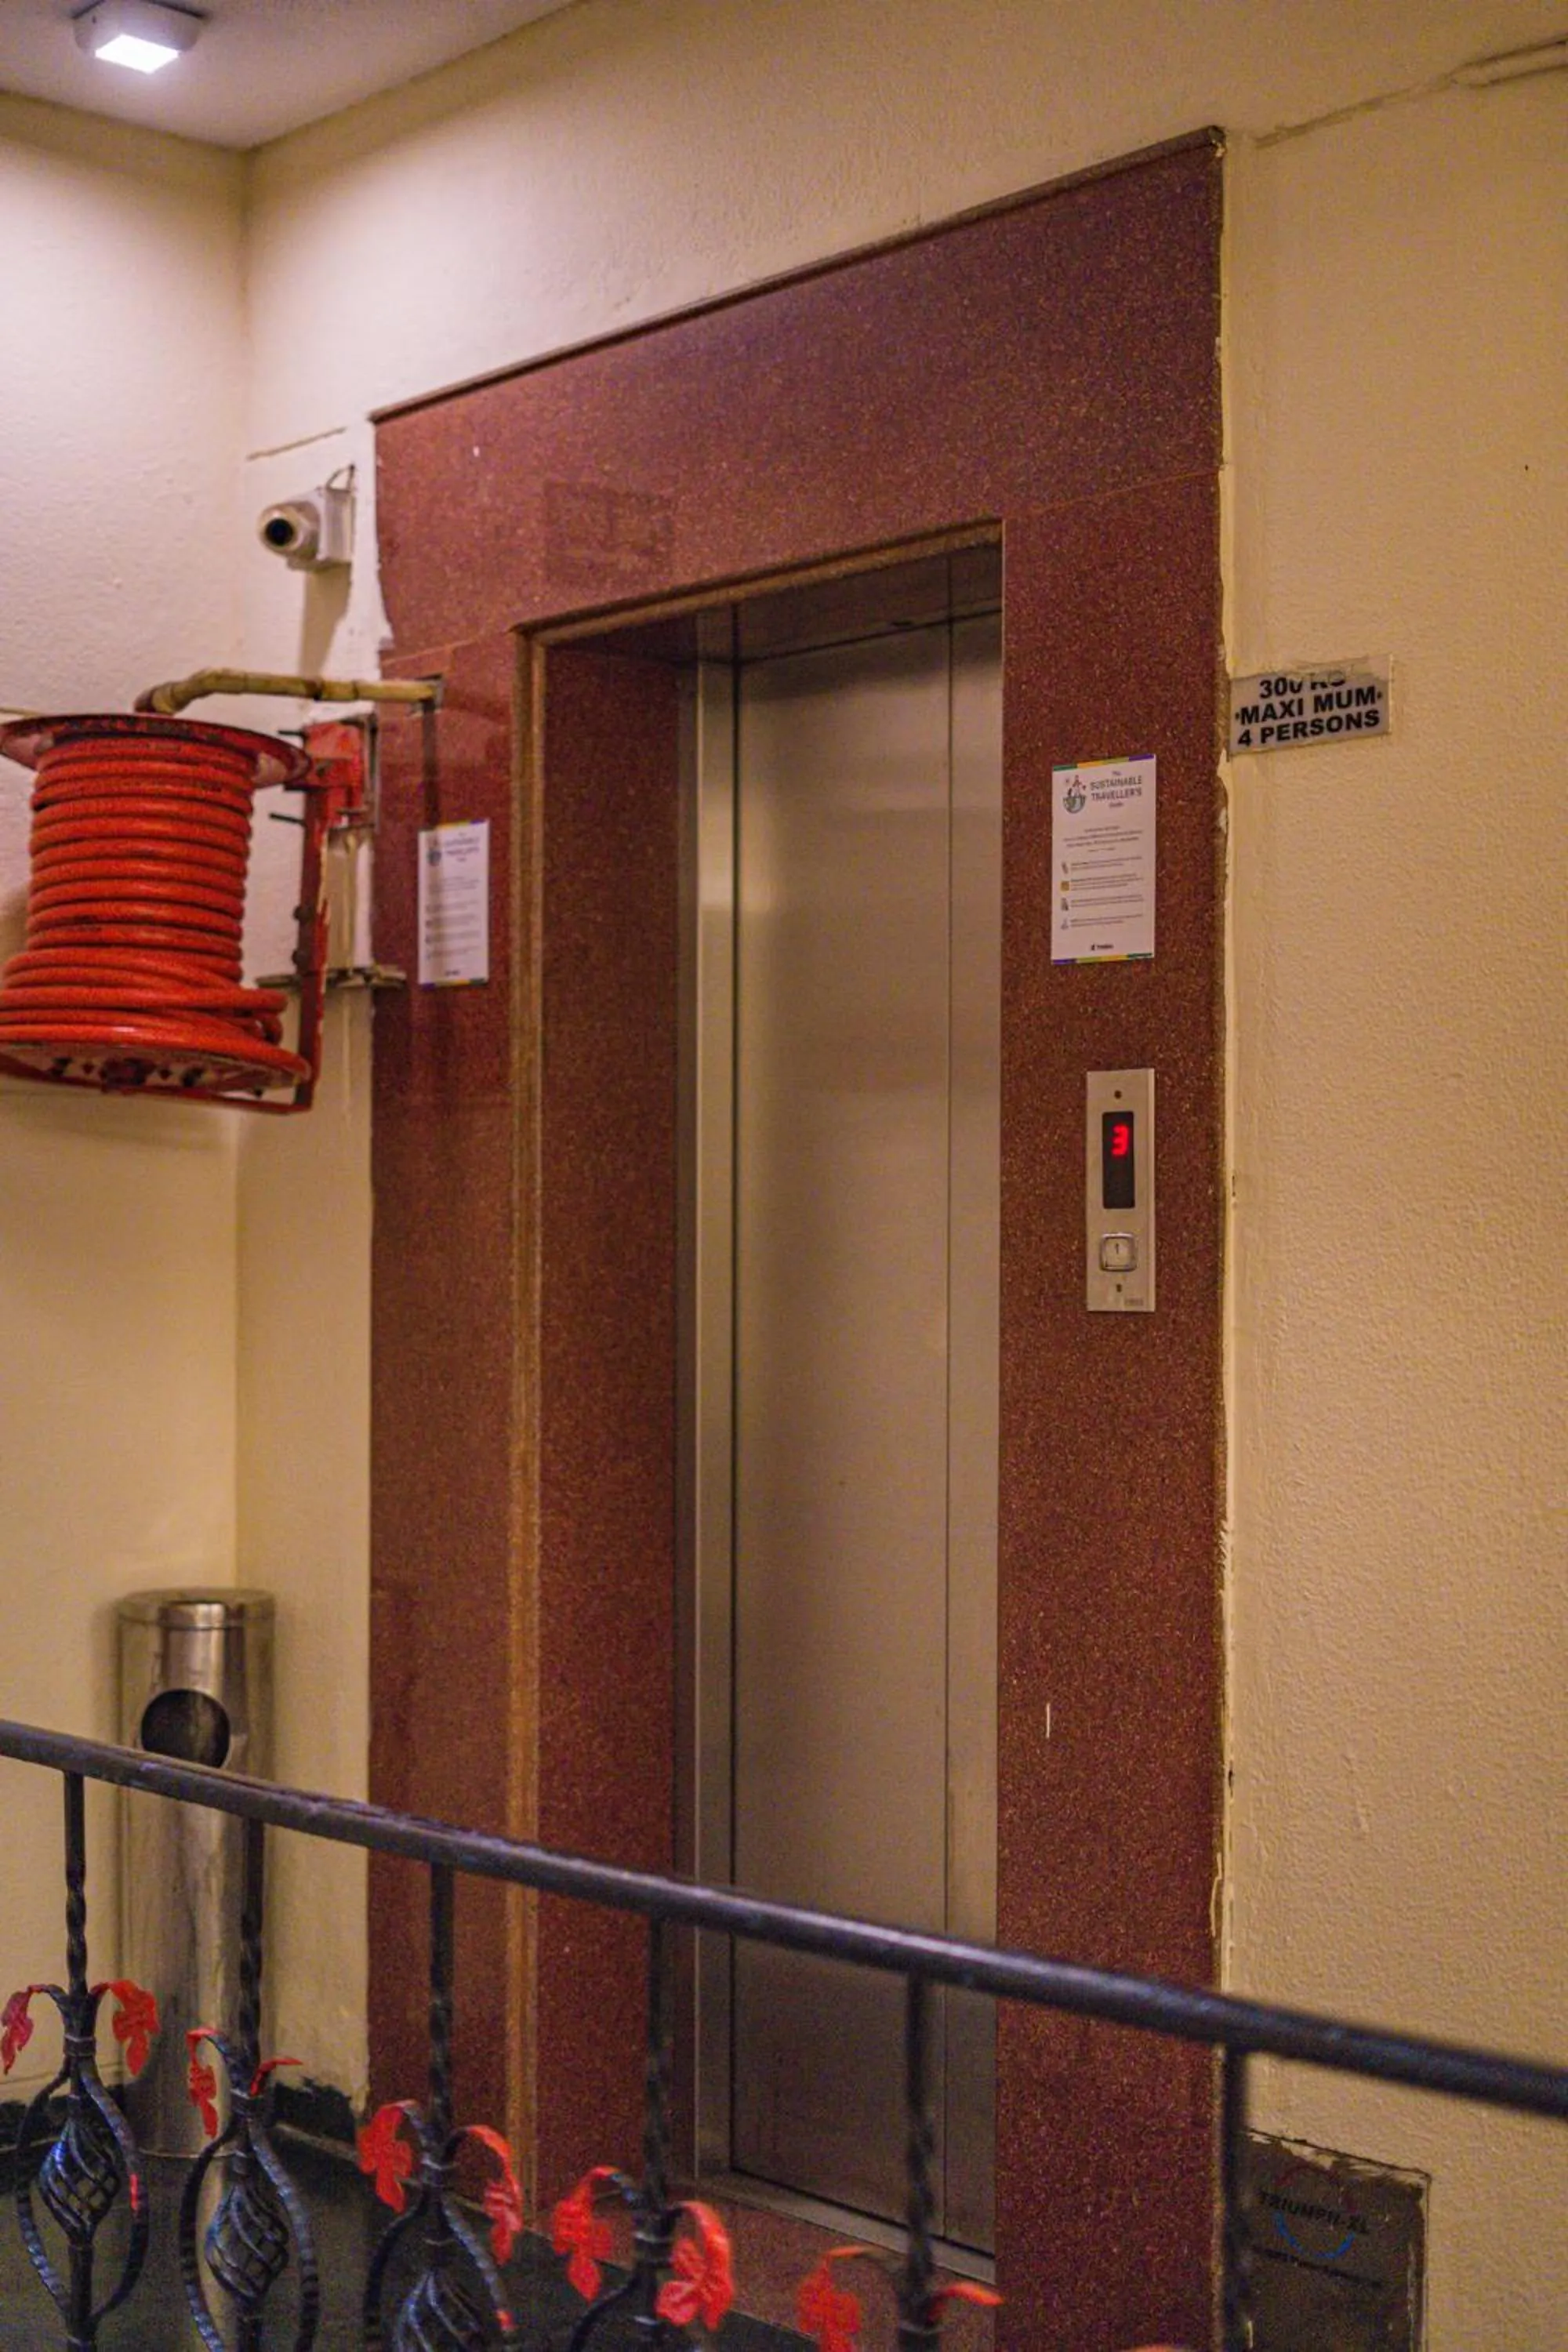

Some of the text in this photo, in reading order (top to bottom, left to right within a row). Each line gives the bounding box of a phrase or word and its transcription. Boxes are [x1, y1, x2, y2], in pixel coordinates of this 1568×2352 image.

[1237, 709, 1381, 747] 4 PERSONS
[1090, 775, 1142, 790] SUSTAINABLE
[1111, 1123, 1129, 1156] 3
